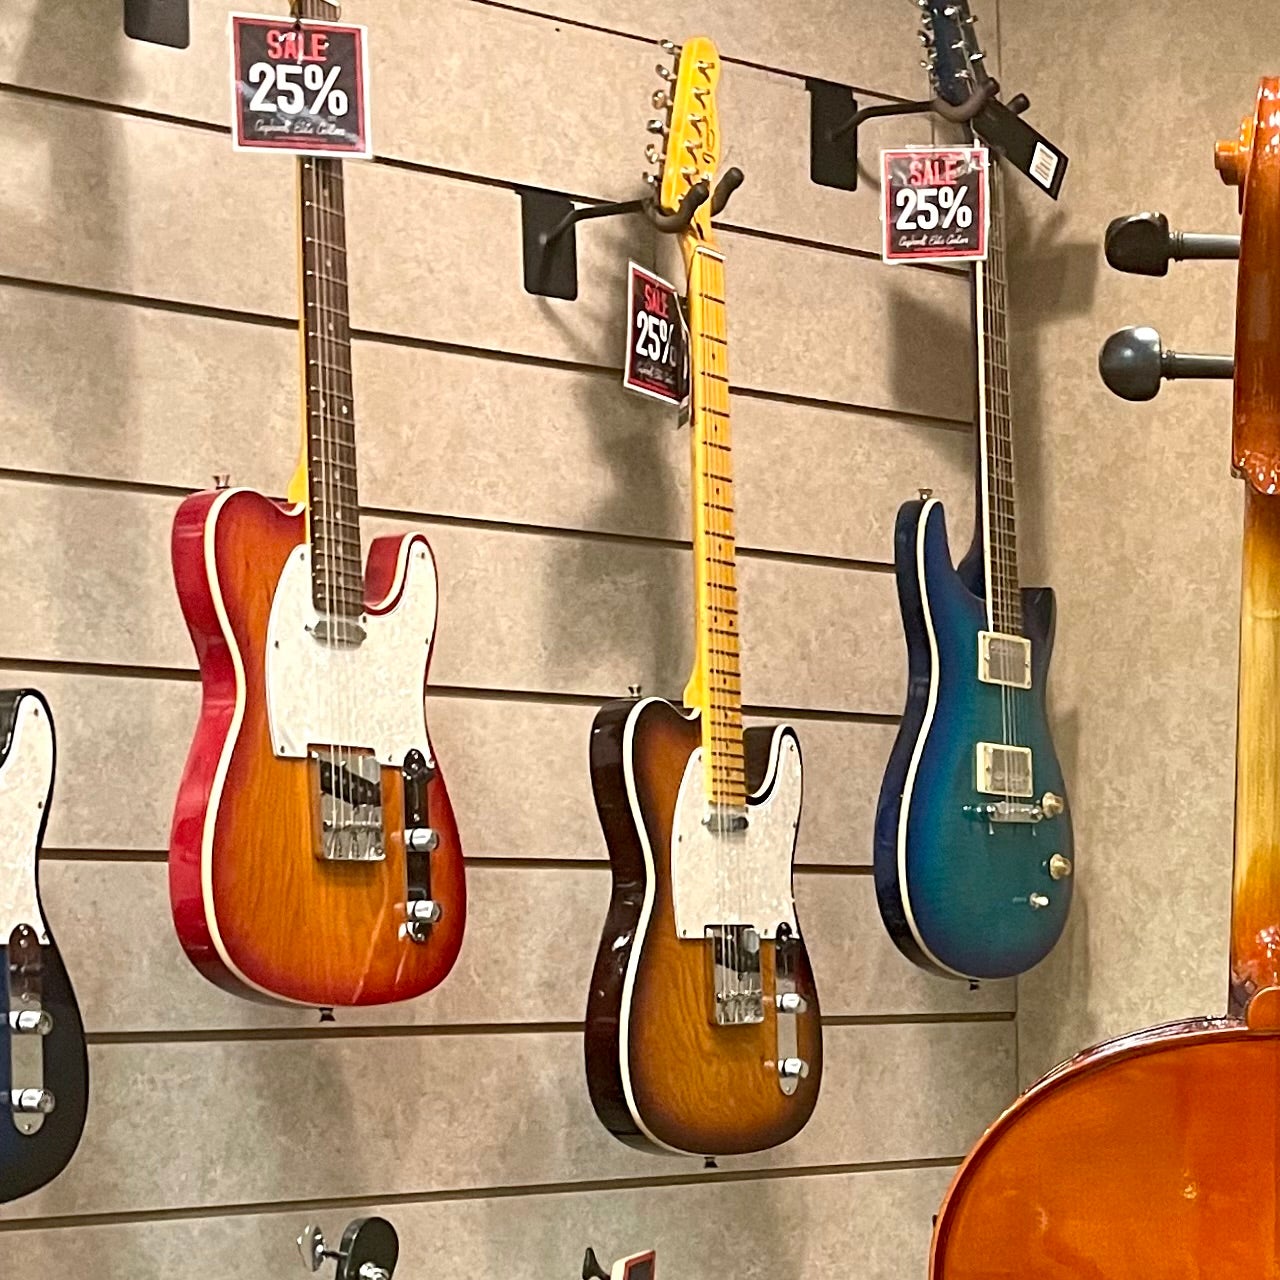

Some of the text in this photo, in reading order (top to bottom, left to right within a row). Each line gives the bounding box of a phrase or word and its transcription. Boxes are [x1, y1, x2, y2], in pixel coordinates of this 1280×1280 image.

[266, 29, 328, 61] SALE
[248, 62, 348, 116] 25%
[909, 160, 957, 186] SALE
[895, 185, 973, 230] 25%
[644, 283, 669, 319] SALE
[635, 310, 677, 367] 25%
